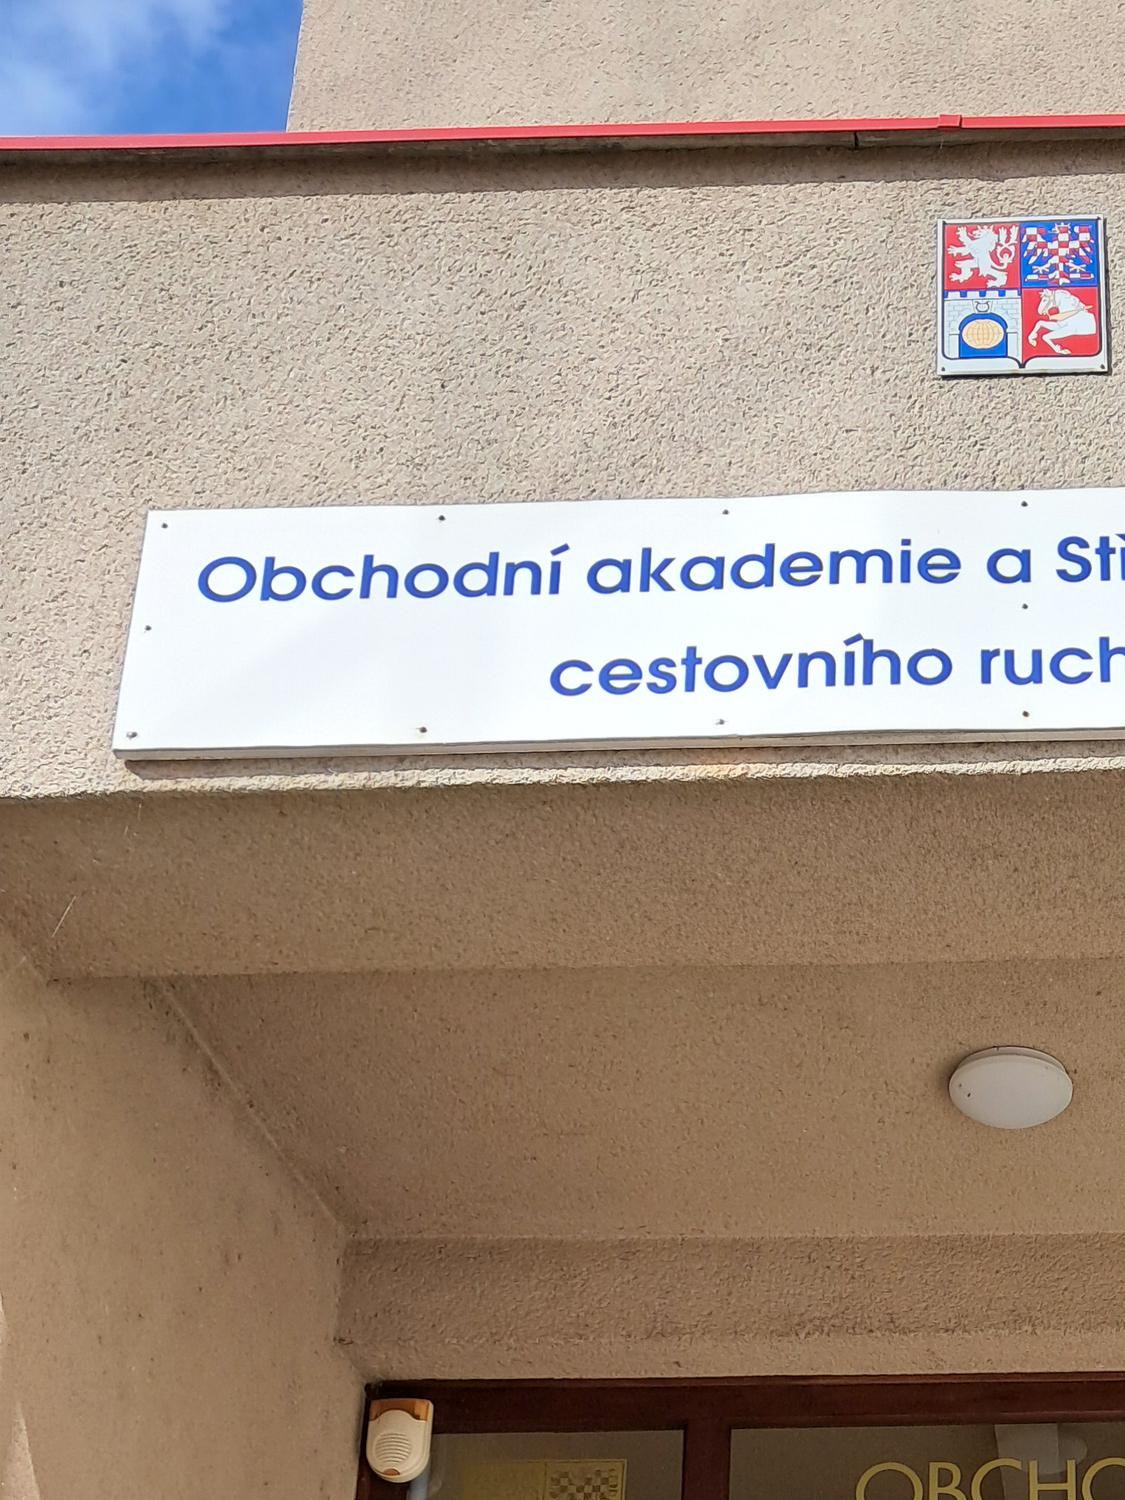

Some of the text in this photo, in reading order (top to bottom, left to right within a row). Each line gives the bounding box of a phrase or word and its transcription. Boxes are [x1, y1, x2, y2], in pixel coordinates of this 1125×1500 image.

[197, 543, 570, 603] Obchodní
[586, 537, 961, 595] akademie
[986, 548, 1032, 584] a
[549, 633, 953, 697] cestovního
